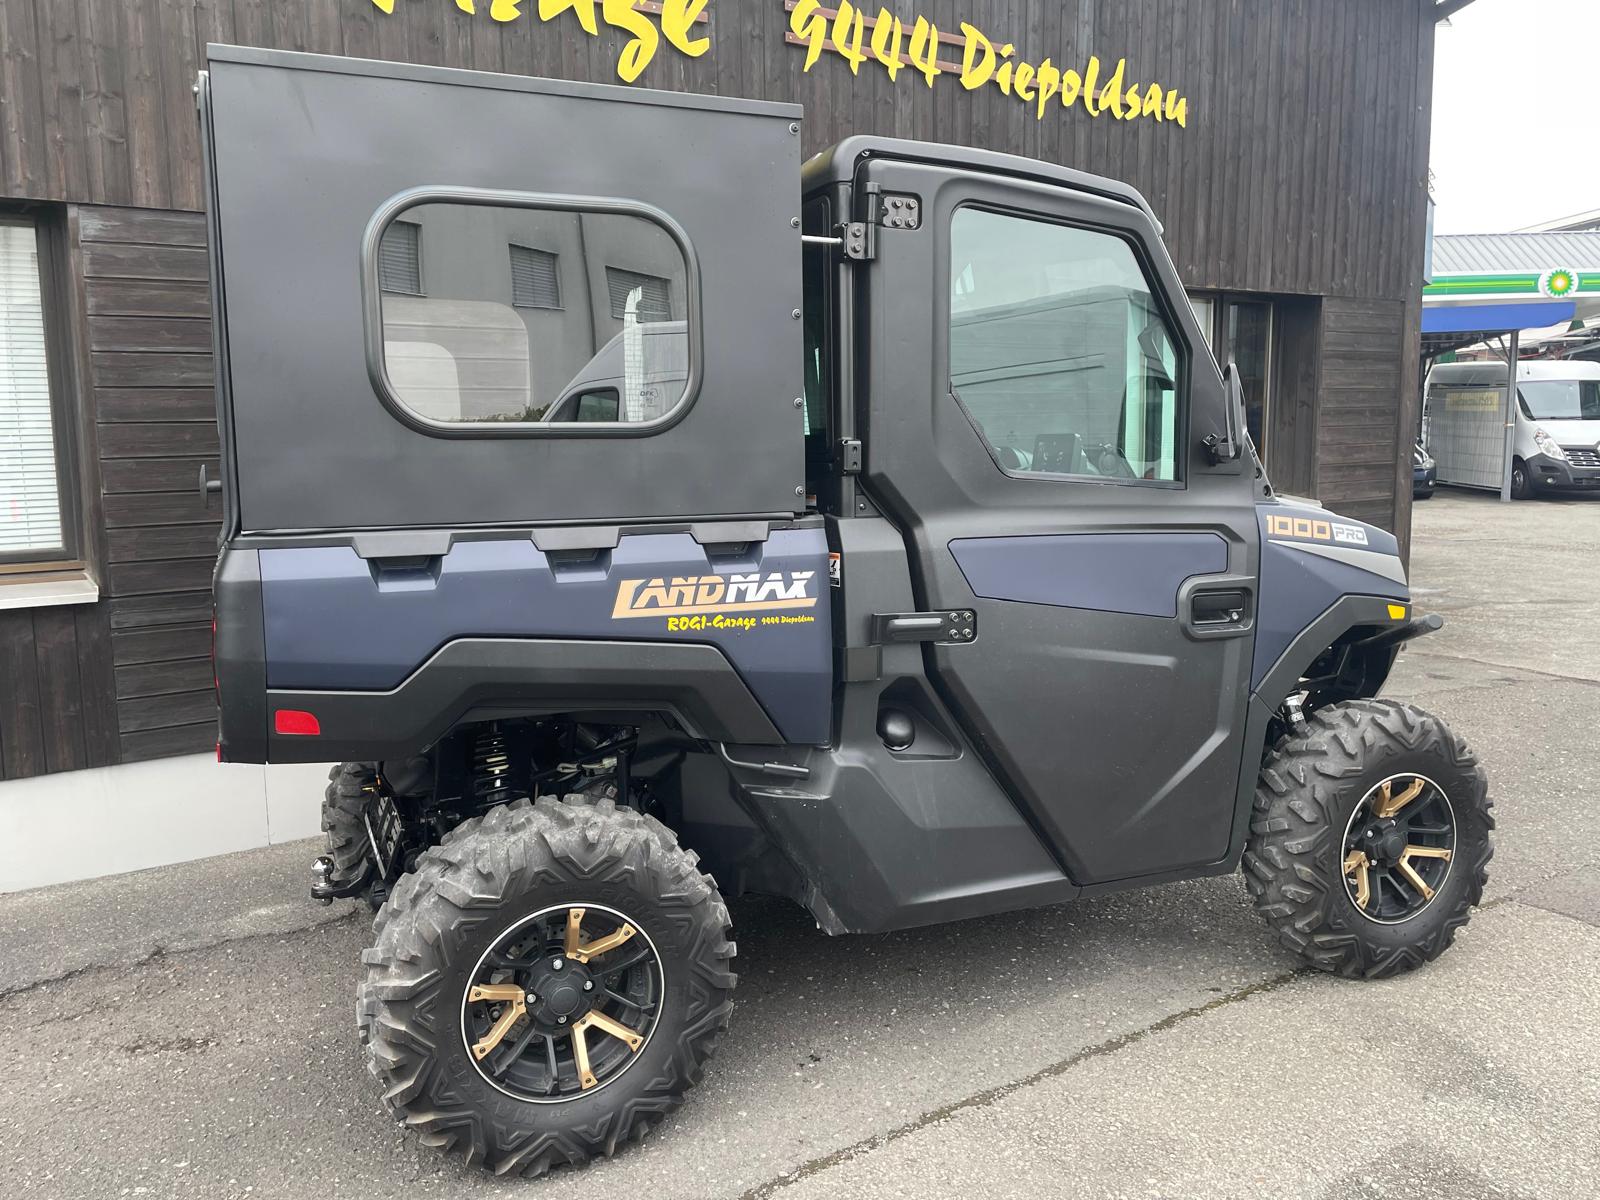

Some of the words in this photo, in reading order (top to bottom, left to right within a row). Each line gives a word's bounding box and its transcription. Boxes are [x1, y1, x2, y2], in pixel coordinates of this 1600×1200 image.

[790, 0, 941, 88] 9444
[960, 22, 1187, 128] Diepoldsau
[1266, 515, 1331, 540] 1000
[1333, 525, 1366, 542] PRO
[611, 571, 817, 619] LANDMAX
[667, 614, 757, 632] ROGI-Garage
